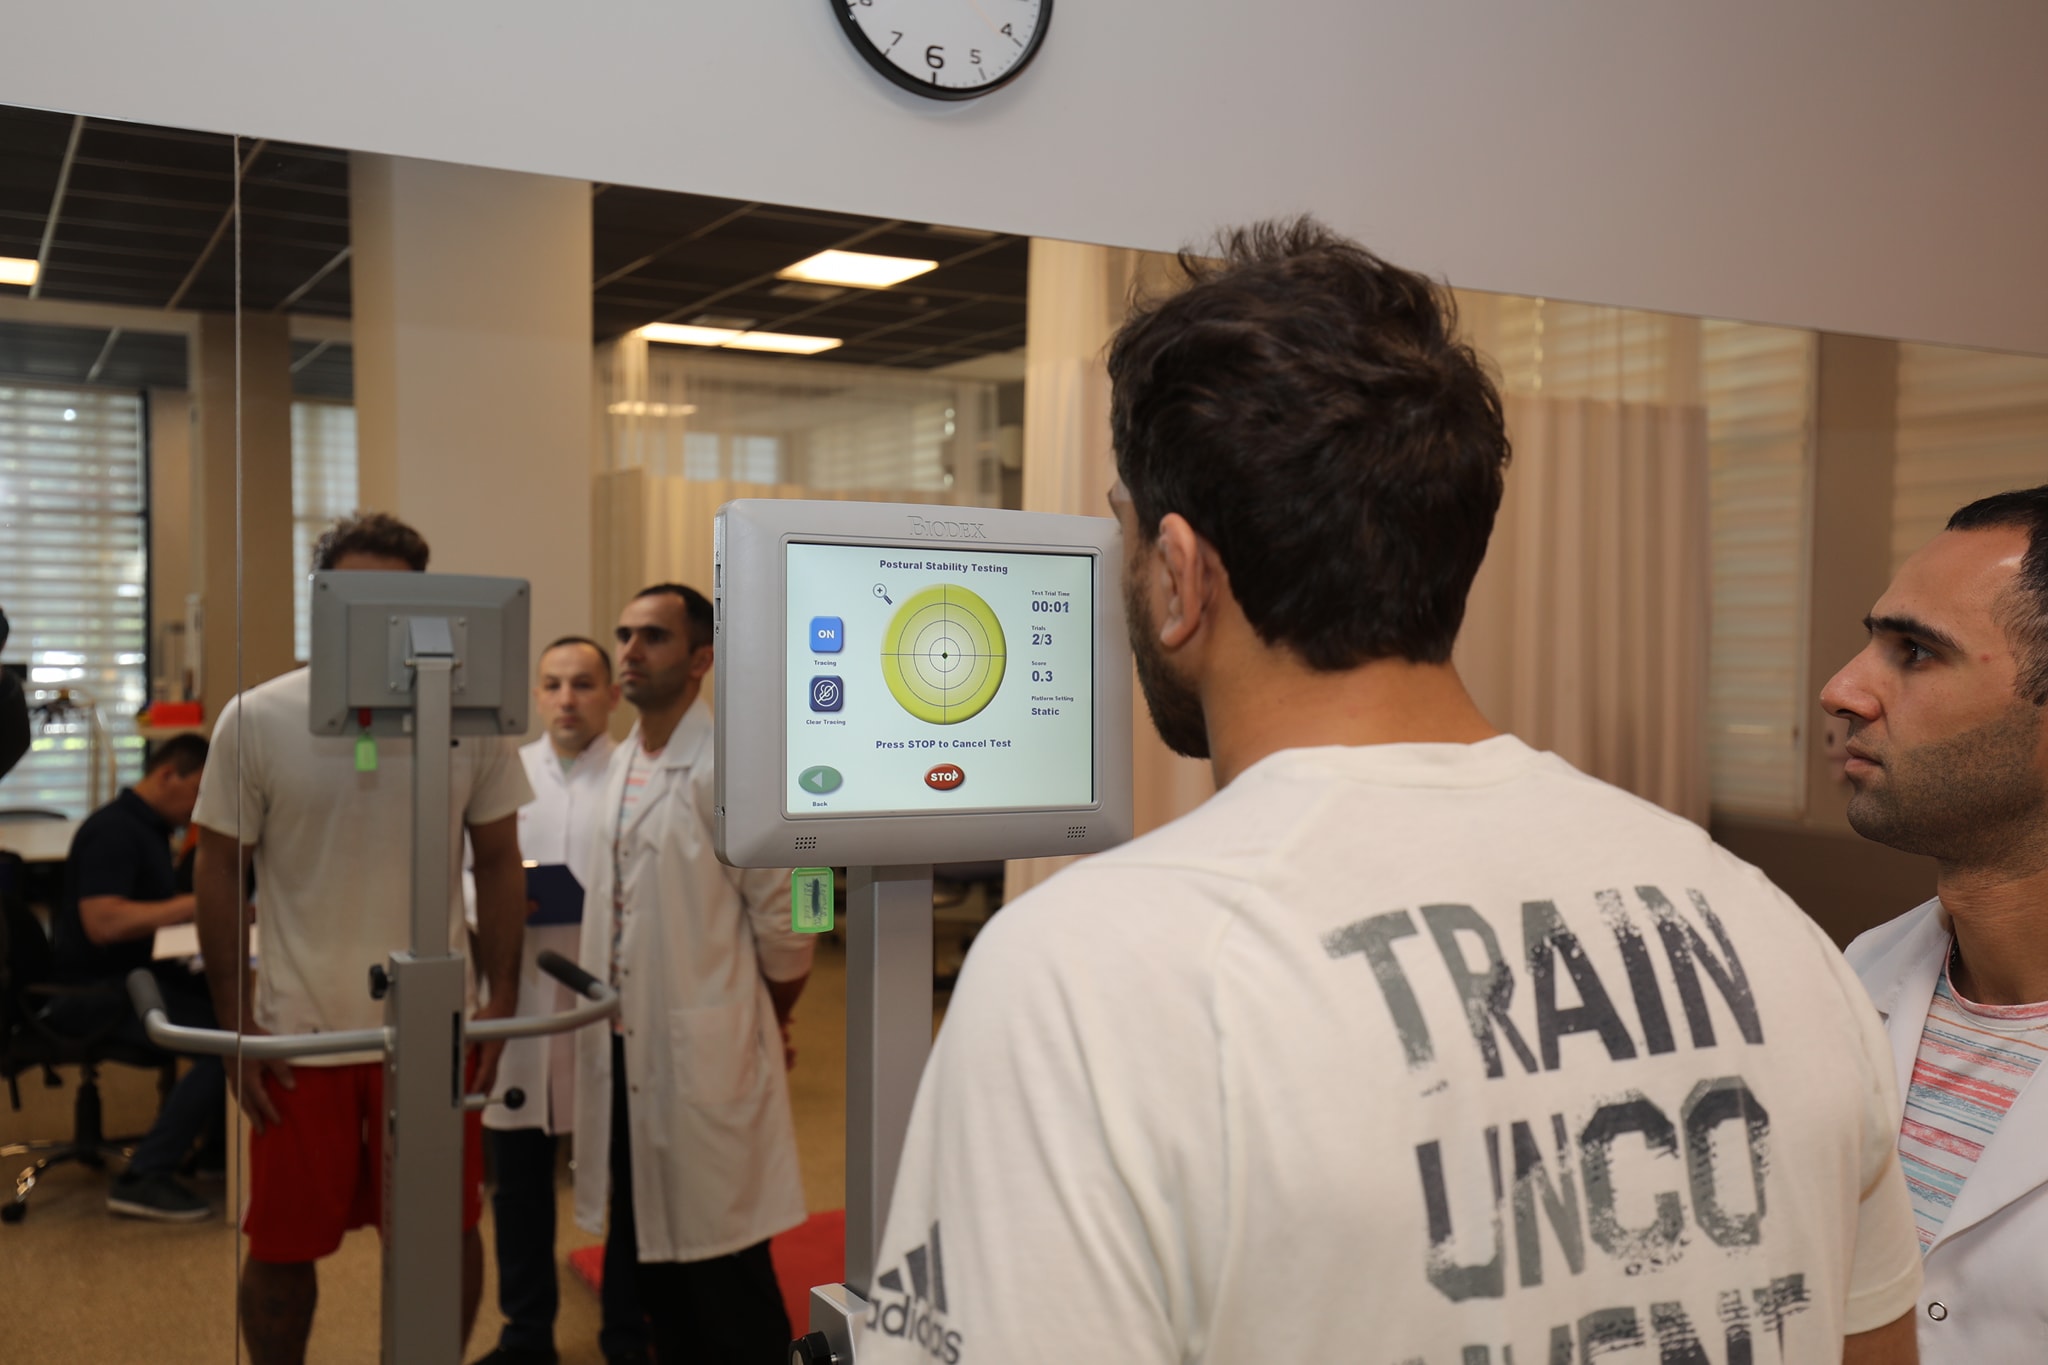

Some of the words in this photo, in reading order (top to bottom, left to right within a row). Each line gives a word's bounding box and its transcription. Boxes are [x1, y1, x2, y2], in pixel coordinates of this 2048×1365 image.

[1000, 23, 1013, 37] 4
[890, 31, 903, 47] 7
[925, 45, 945, 69] 6
[969, 49, 982, 65] 5
[879, 560, 923, 570] Postural
[925, 561, 968, 574] Stability
[971, 563, 1008, 575] Testing
[1031, 600, 1070, 613] 00:01
[818, 630, 834, 638] ON
[1032, 633, 1053, 646] 2/3
[1031, 670, 1053, 682] 0.3
[1031, 707, 1060, 716] Static
[876, 740, 904, 749] Press
[908, 740, 936, 749] STOP
[938, 740, 949, 749] to
[952, 739, 987, 749] Cancel
[990, 739, 1012, 748] Test
[931, 773, 958, 782] STOP
[1320, 885, 1765, 1079] TRAIN
[1415, 1075, 1770, 1302] UNCO
